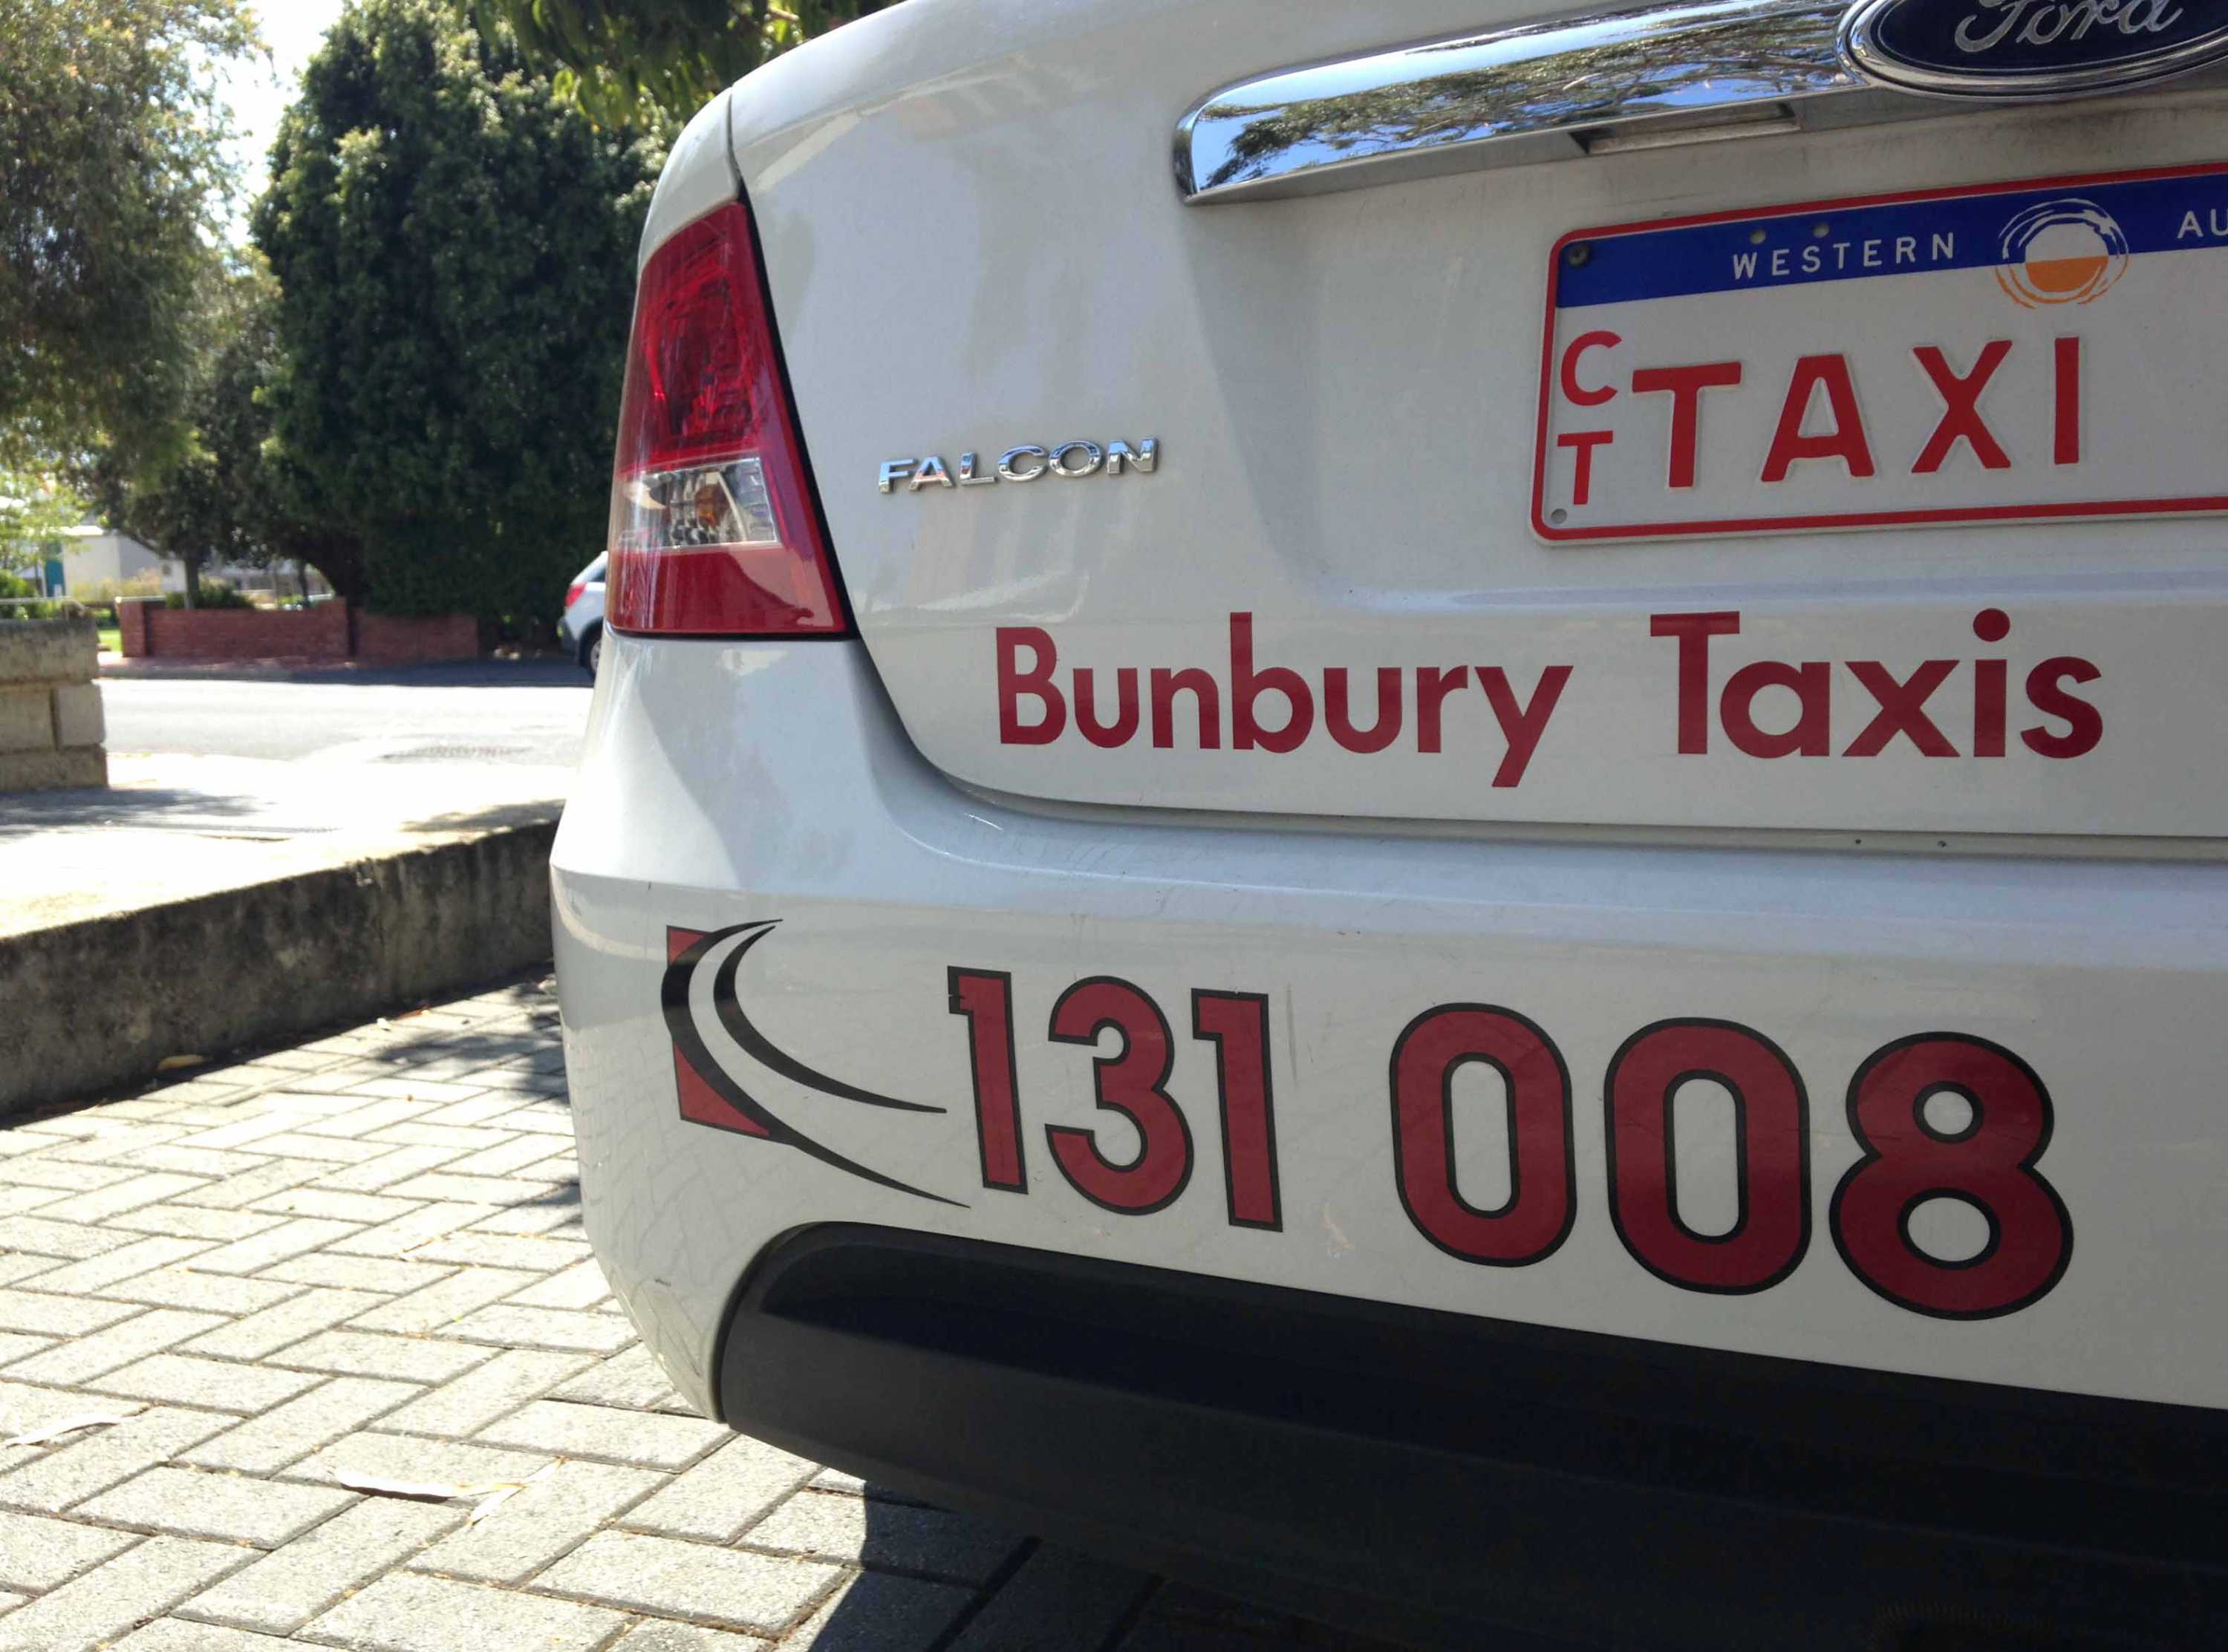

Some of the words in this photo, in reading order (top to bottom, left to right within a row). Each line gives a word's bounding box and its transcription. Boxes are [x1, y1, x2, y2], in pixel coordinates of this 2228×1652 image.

[1733, 232, 1954, 279] WESTERN
[879, 437, 1158, 493] FALCON
[1632, 336, 2079, 488] TAXI
[996, 612, 1574, 787] Bunbury
[1650, 607, 2103, 759] Taxis
[947, 965, 1283, 1233] 131
[1389, 1002, 2074, 1321] 008
